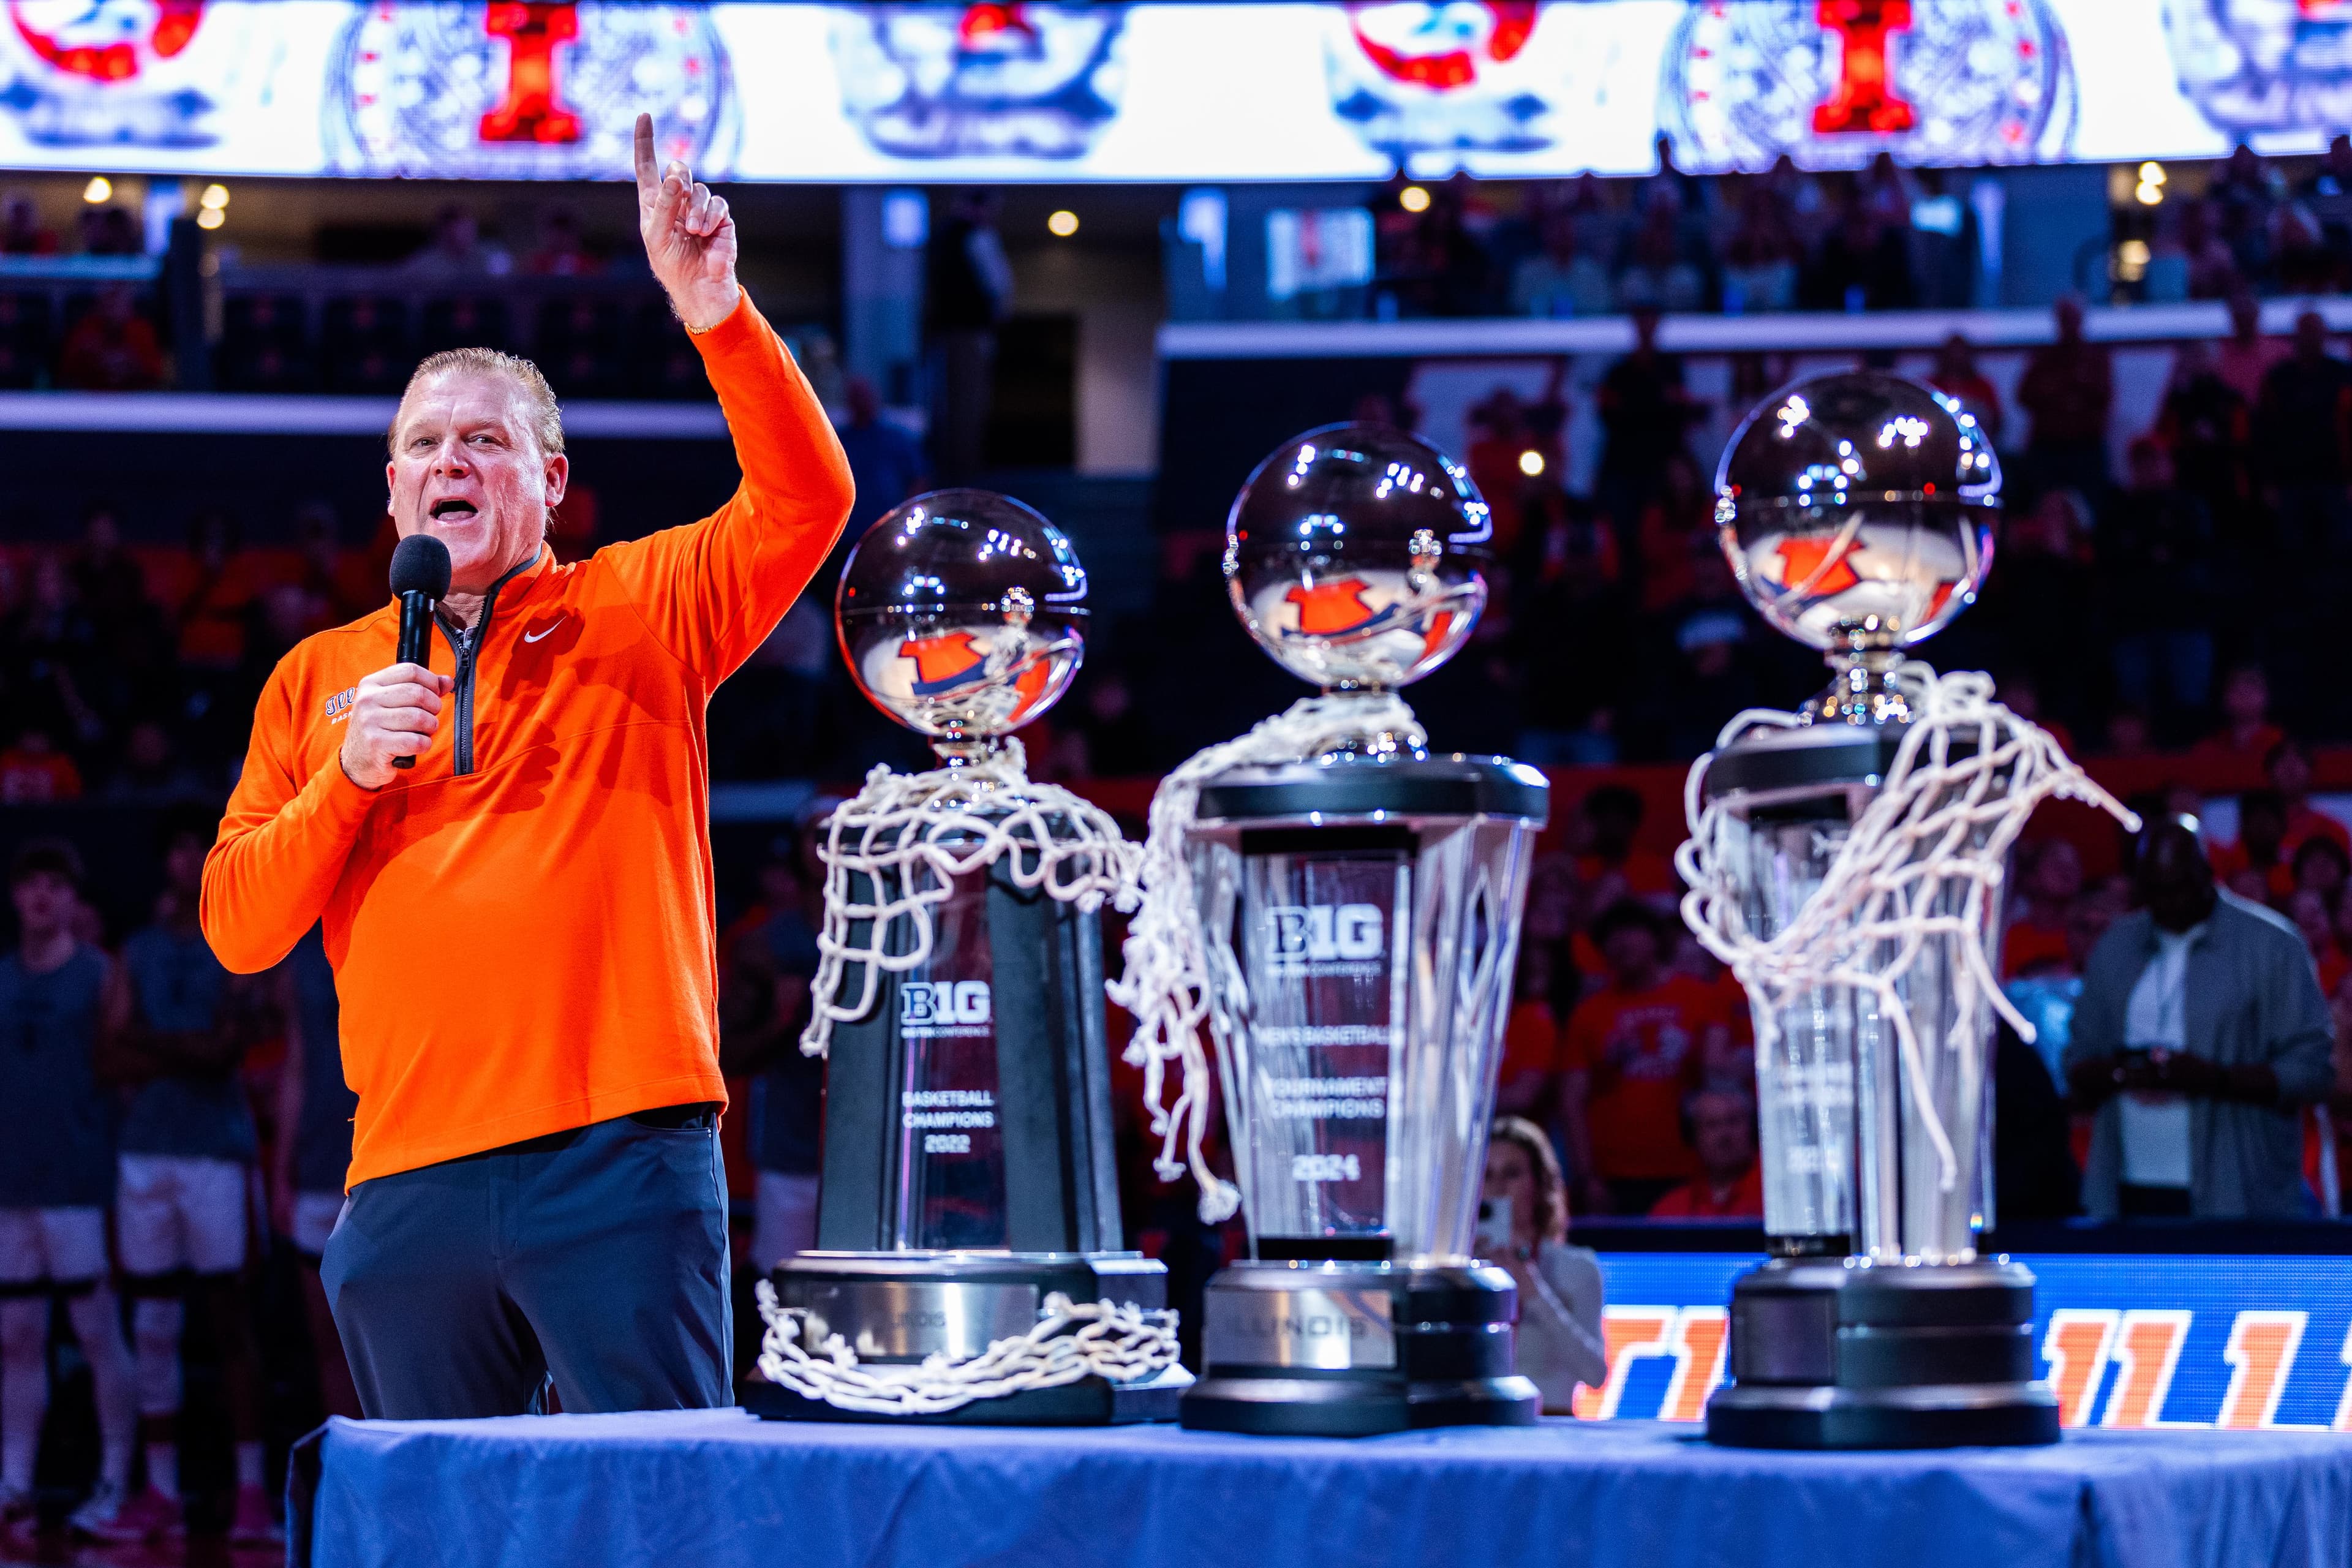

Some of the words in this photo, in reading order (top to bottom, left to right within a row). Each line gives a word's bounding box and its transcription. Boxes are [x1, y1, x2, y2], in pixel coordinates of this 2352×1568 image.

[902, 1090, 995, 1107] BASKETBALL
[1269, 1098, 1385, 1119] CHAMPIONS
[902, 1112, 995, 1128] CHAMPIONS
[925, 1134, 971, 1153] 2022
[1292, 1154, 1361, 1181] 2024
